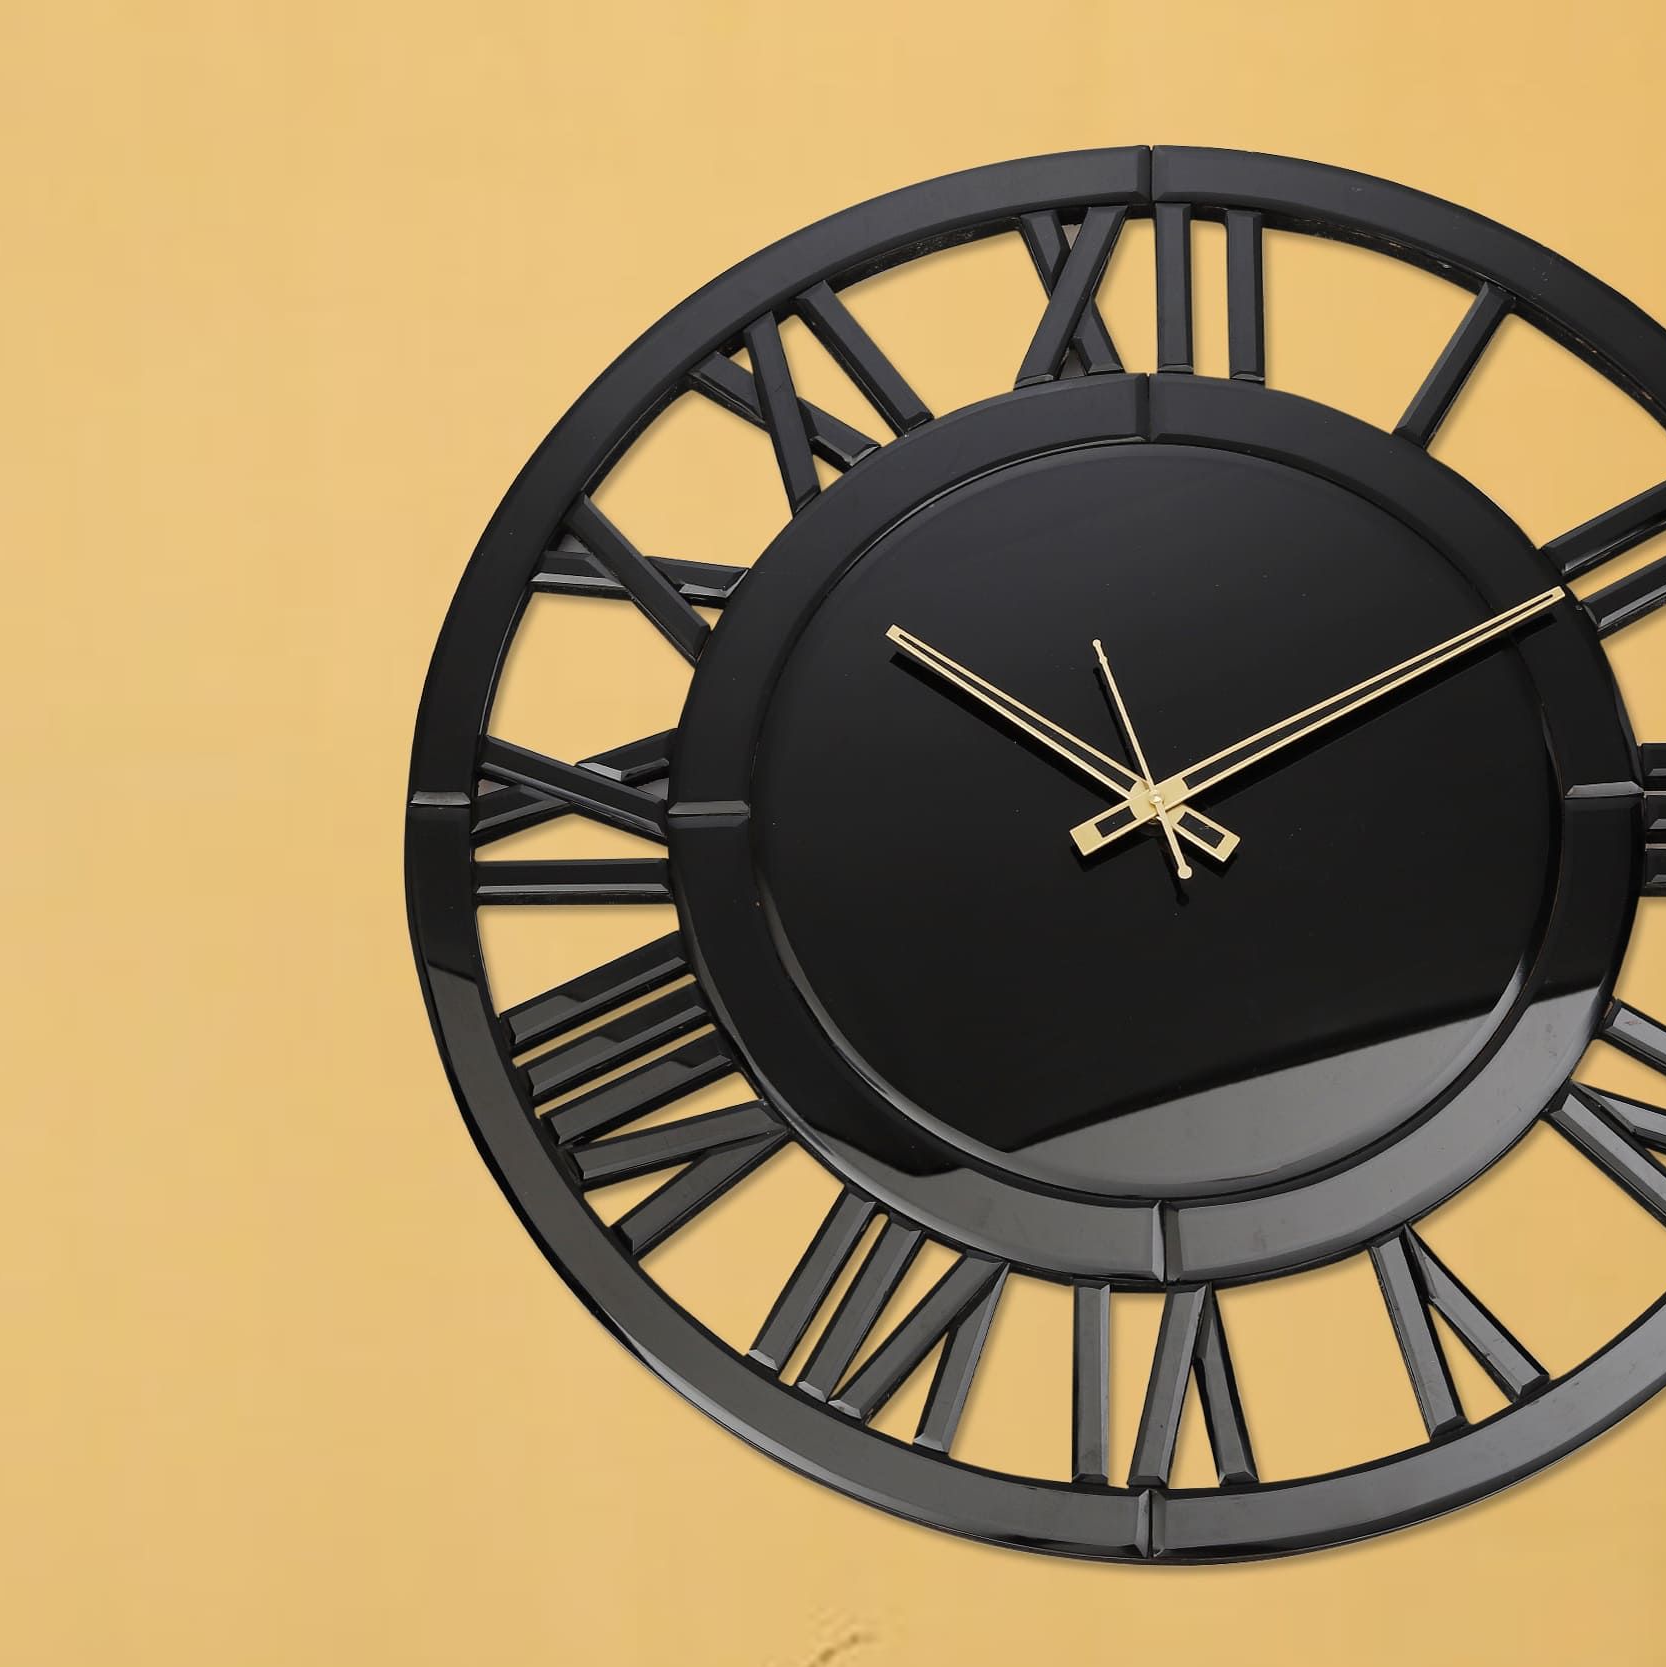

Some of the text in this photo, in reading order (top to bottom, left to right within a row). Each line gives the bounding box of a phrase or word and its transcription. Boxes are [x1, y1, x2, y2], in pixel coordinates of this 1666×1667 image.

[1013, 202, 1266, 388] XII
[686, 280, 935, 515] XI
[530, 495, 751, 668] X
